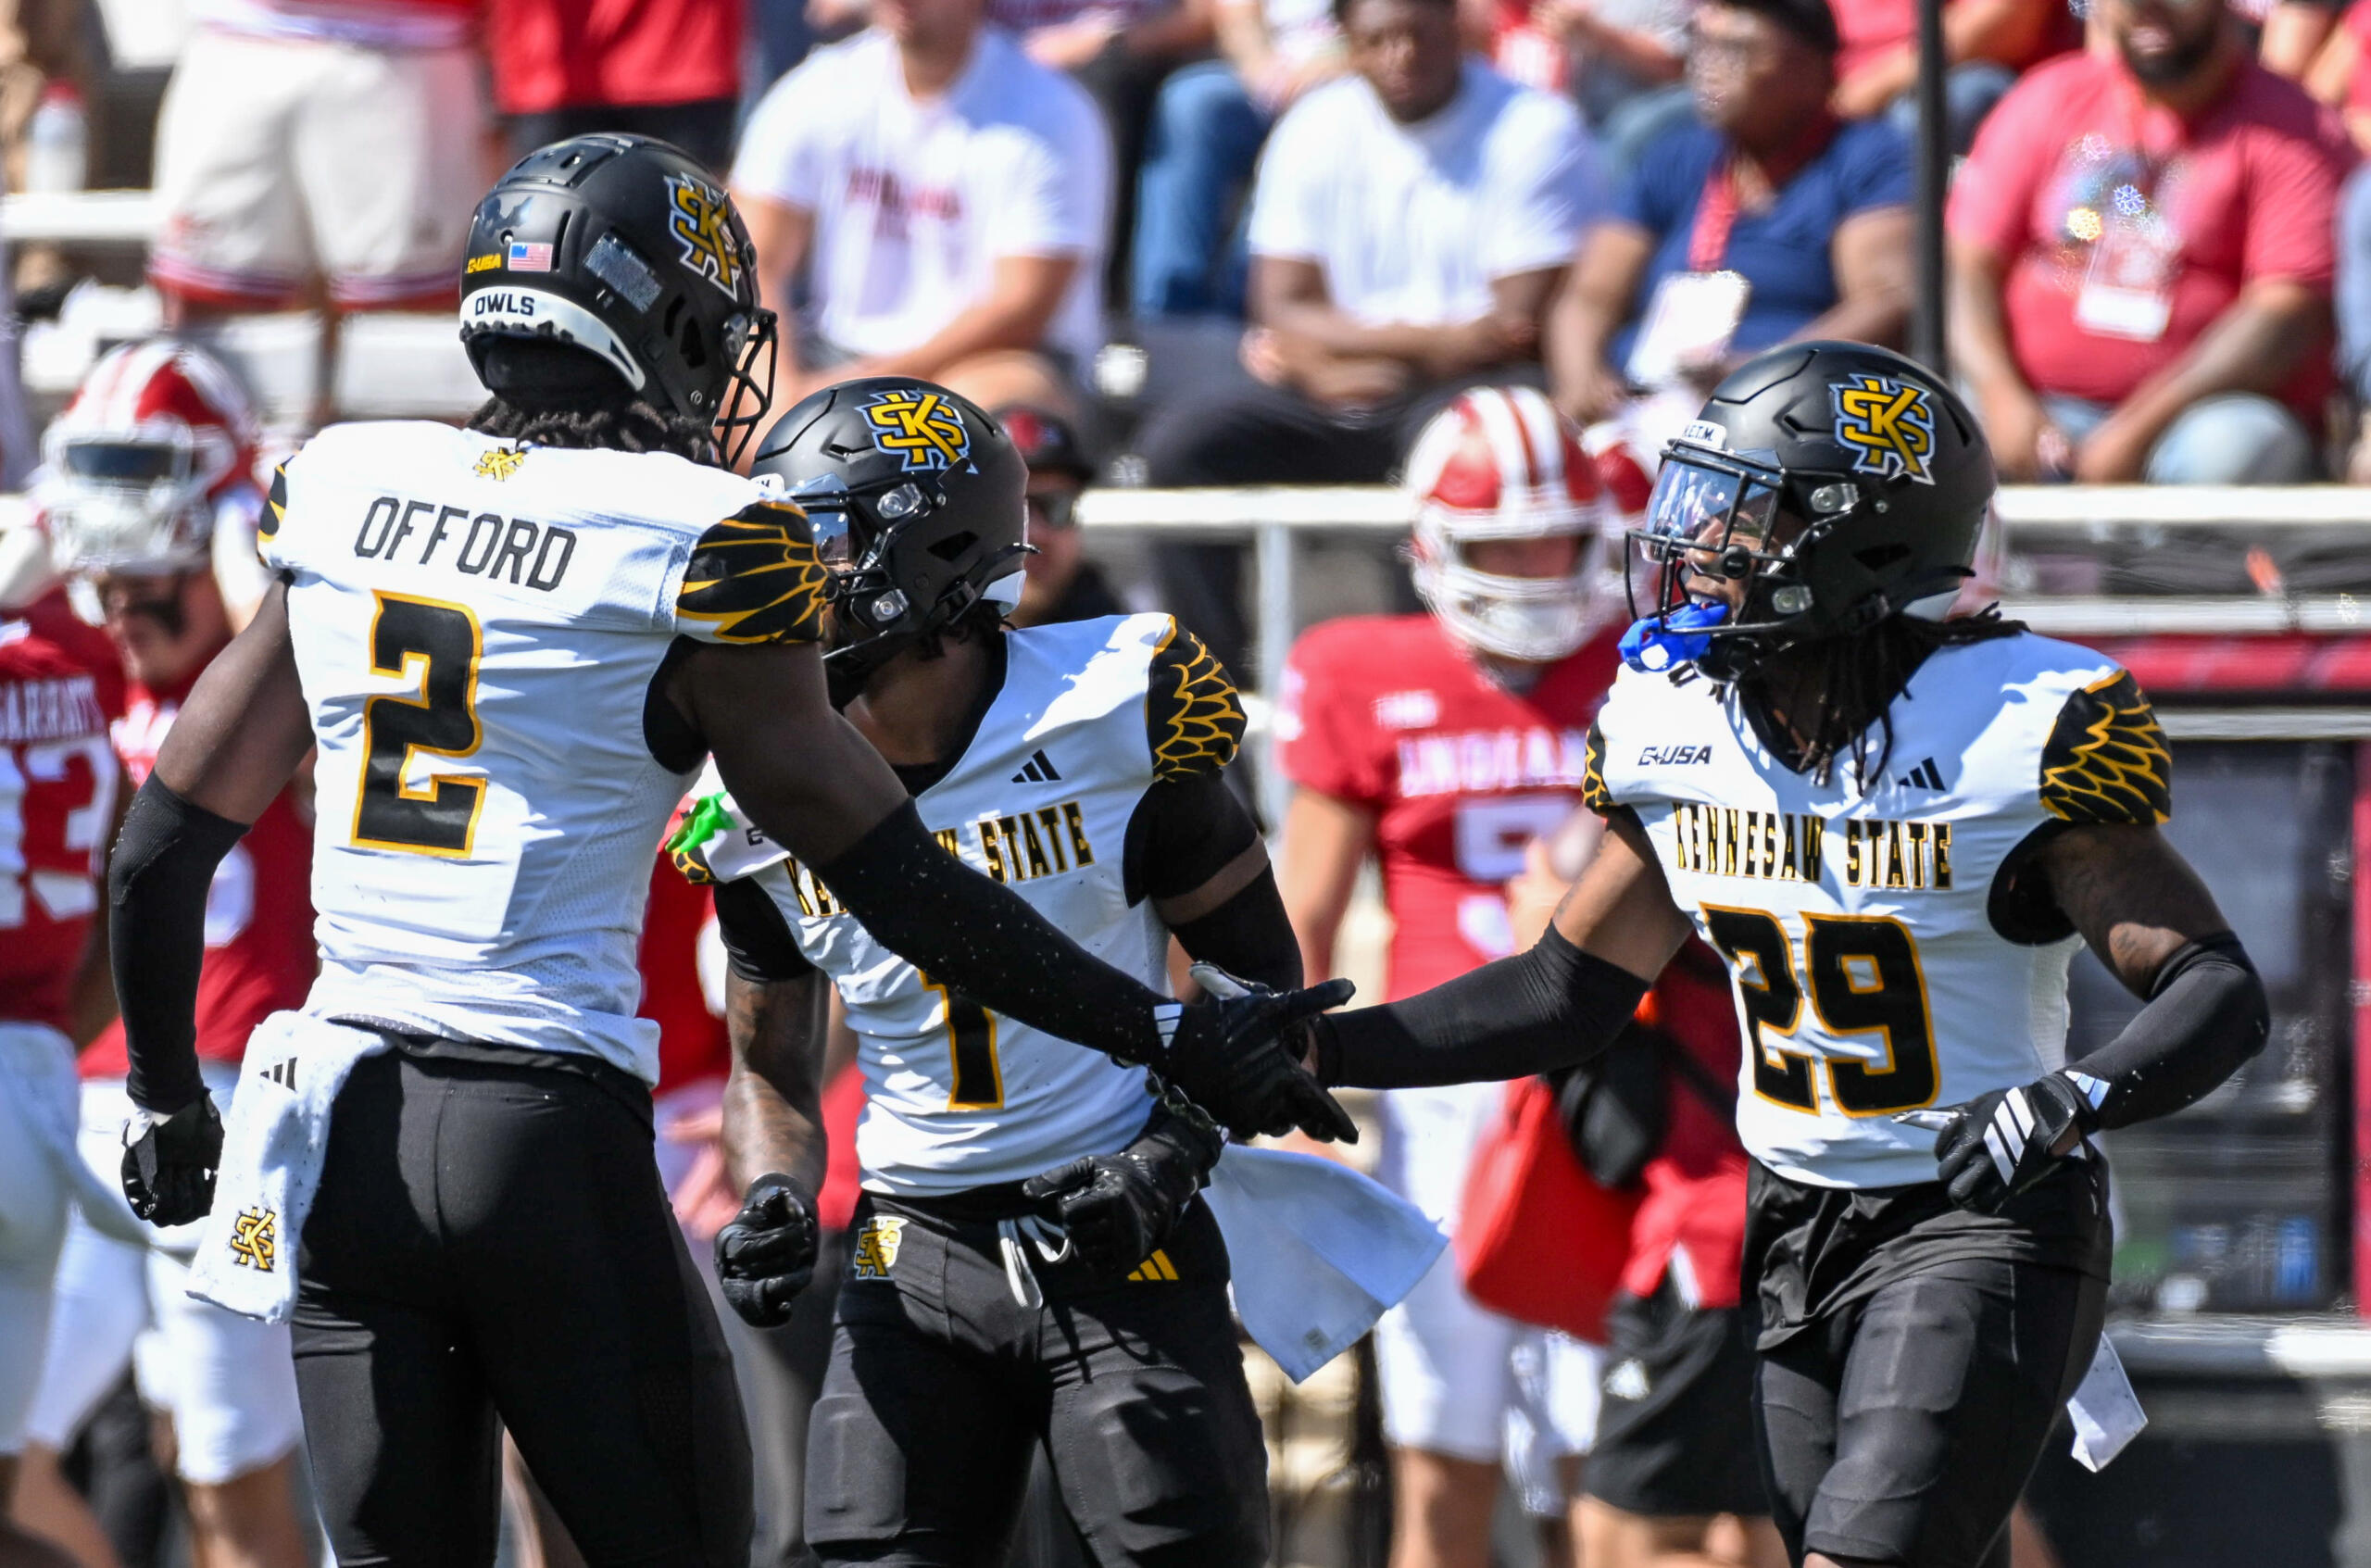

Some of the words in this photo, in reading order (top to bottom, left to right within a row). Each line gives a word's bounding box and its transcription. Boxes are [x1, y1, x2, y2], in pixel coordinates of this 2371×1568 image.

[474, 293, 535, 317] OWLS
[354, 495, 577, 592] OFFORD
[349, 588, 487, 859] 2
[977, 801, 1096, 885] STATE
[1672, 801, 1827, 883] KENNESAW
[1846, 818, 1952, 890] STATE
[1699, 901, 1941, 1119] 29
